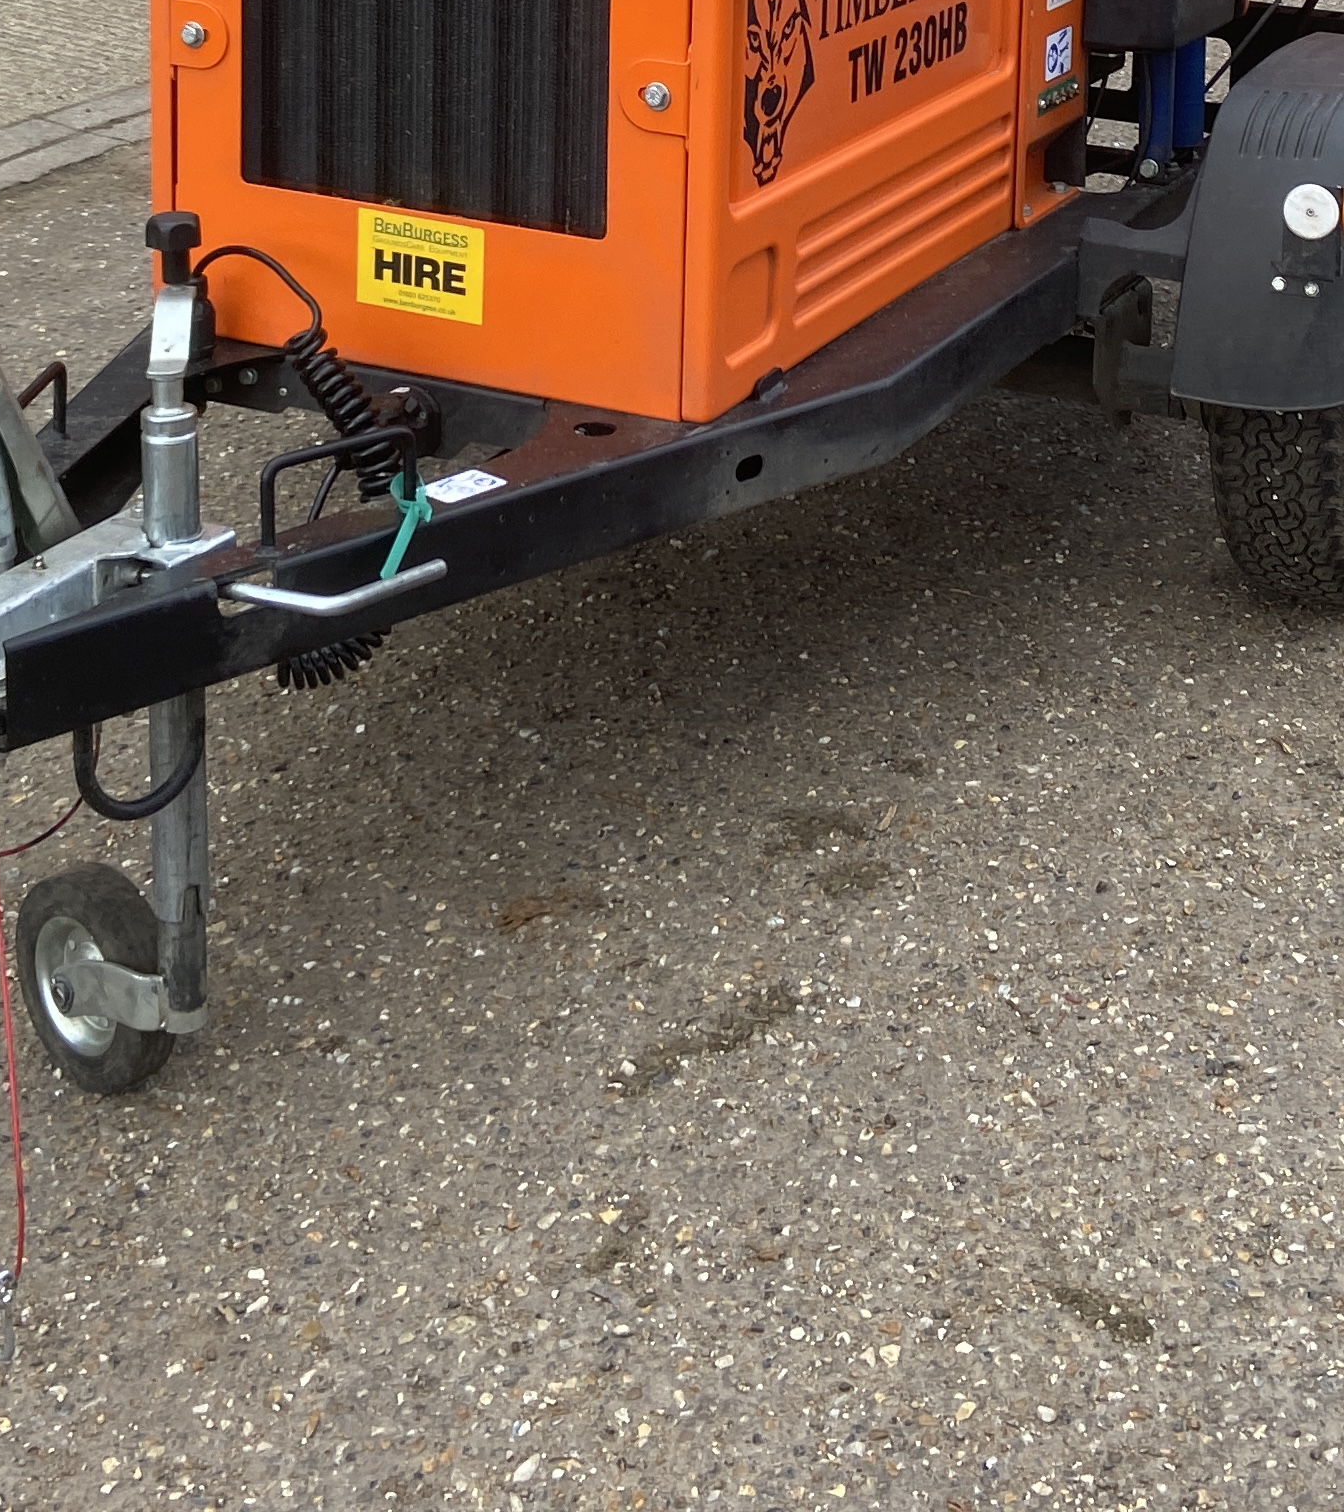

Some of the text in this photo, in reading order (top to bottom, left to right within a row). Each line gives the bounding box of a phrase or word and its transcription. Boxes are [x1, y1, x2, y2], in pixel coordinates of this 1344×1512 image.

[848, 1, 968, 104] TW 230HB
[373, 248, 467, 296] HIRE
